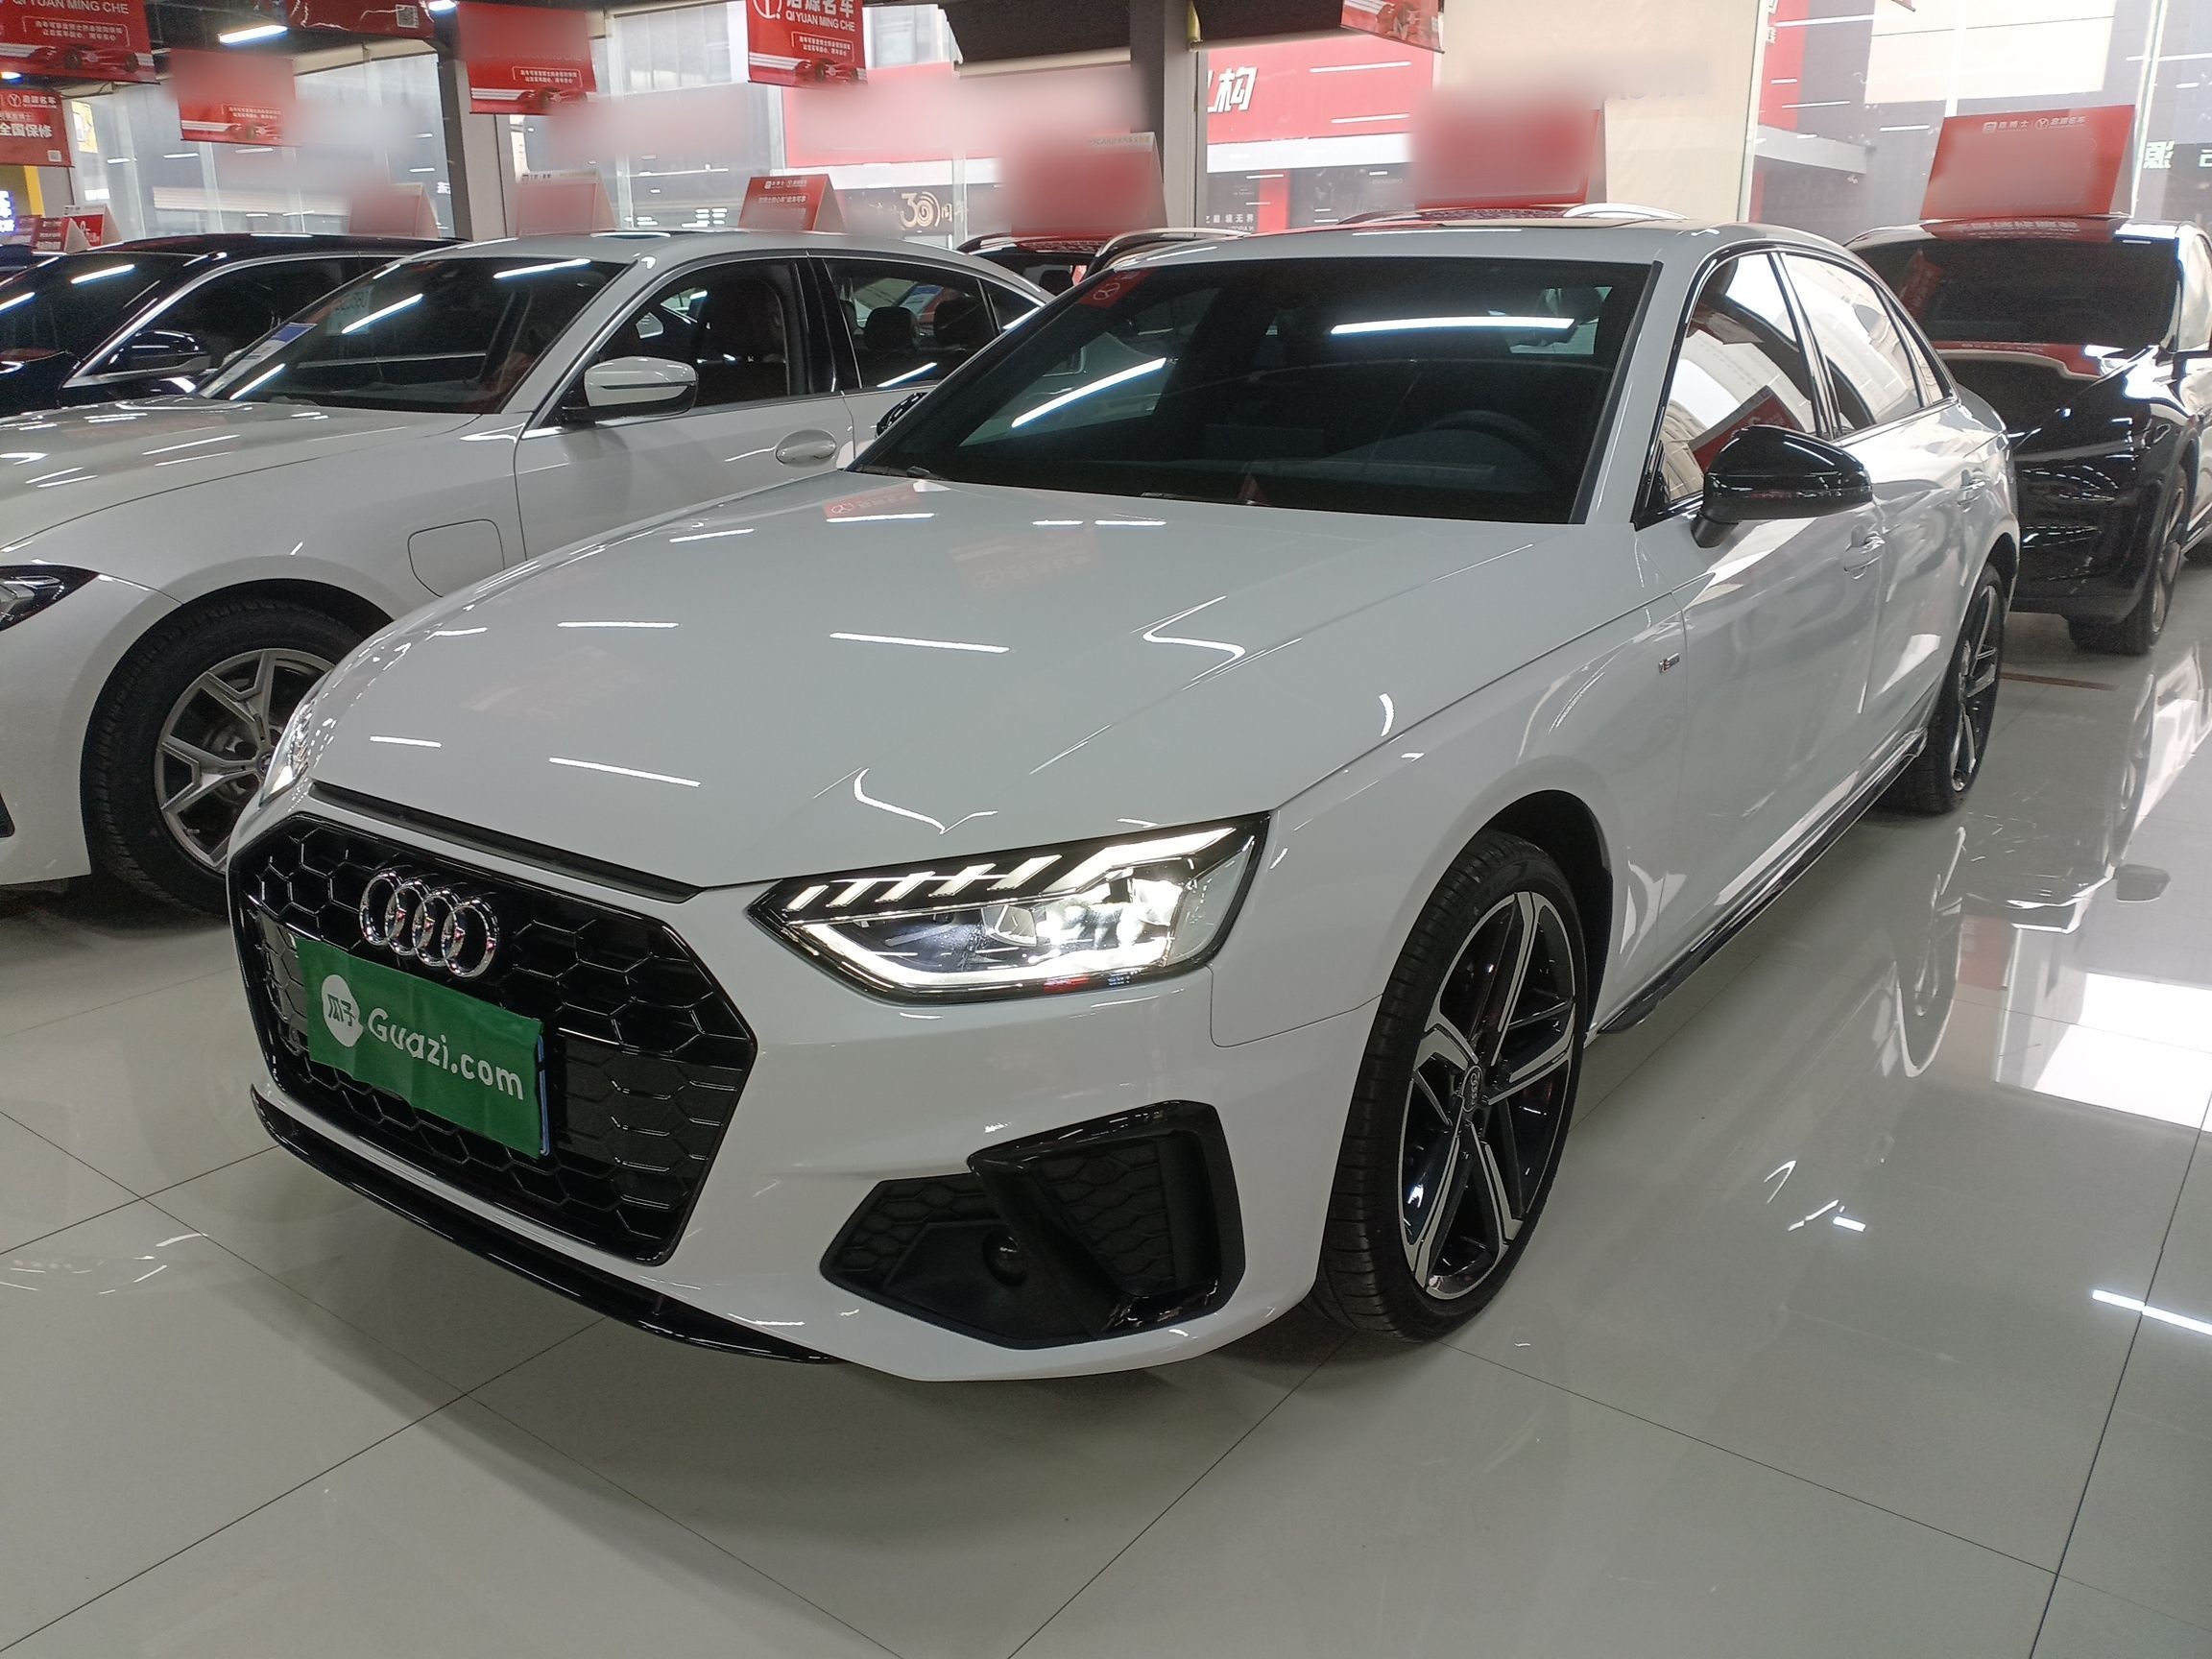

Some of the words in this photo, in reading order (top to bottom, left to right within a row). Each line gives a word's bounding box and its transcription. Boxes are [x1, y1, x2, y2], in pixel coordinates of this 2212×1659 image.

[67, 0, 100, 12] MING
[103, 2, 130, 14] CHE
[785, 10, 795, 21] QI
[795, 12, 818, 26] YUAN
[819, 15, 839, 29] MING
[839, 19, 856, 32] CHE
[0, 122, 53, 138] 全国保修
[326, 992, 356, 1028] 瓜子
[368, 1007, 524, 1101] Guazi.com
